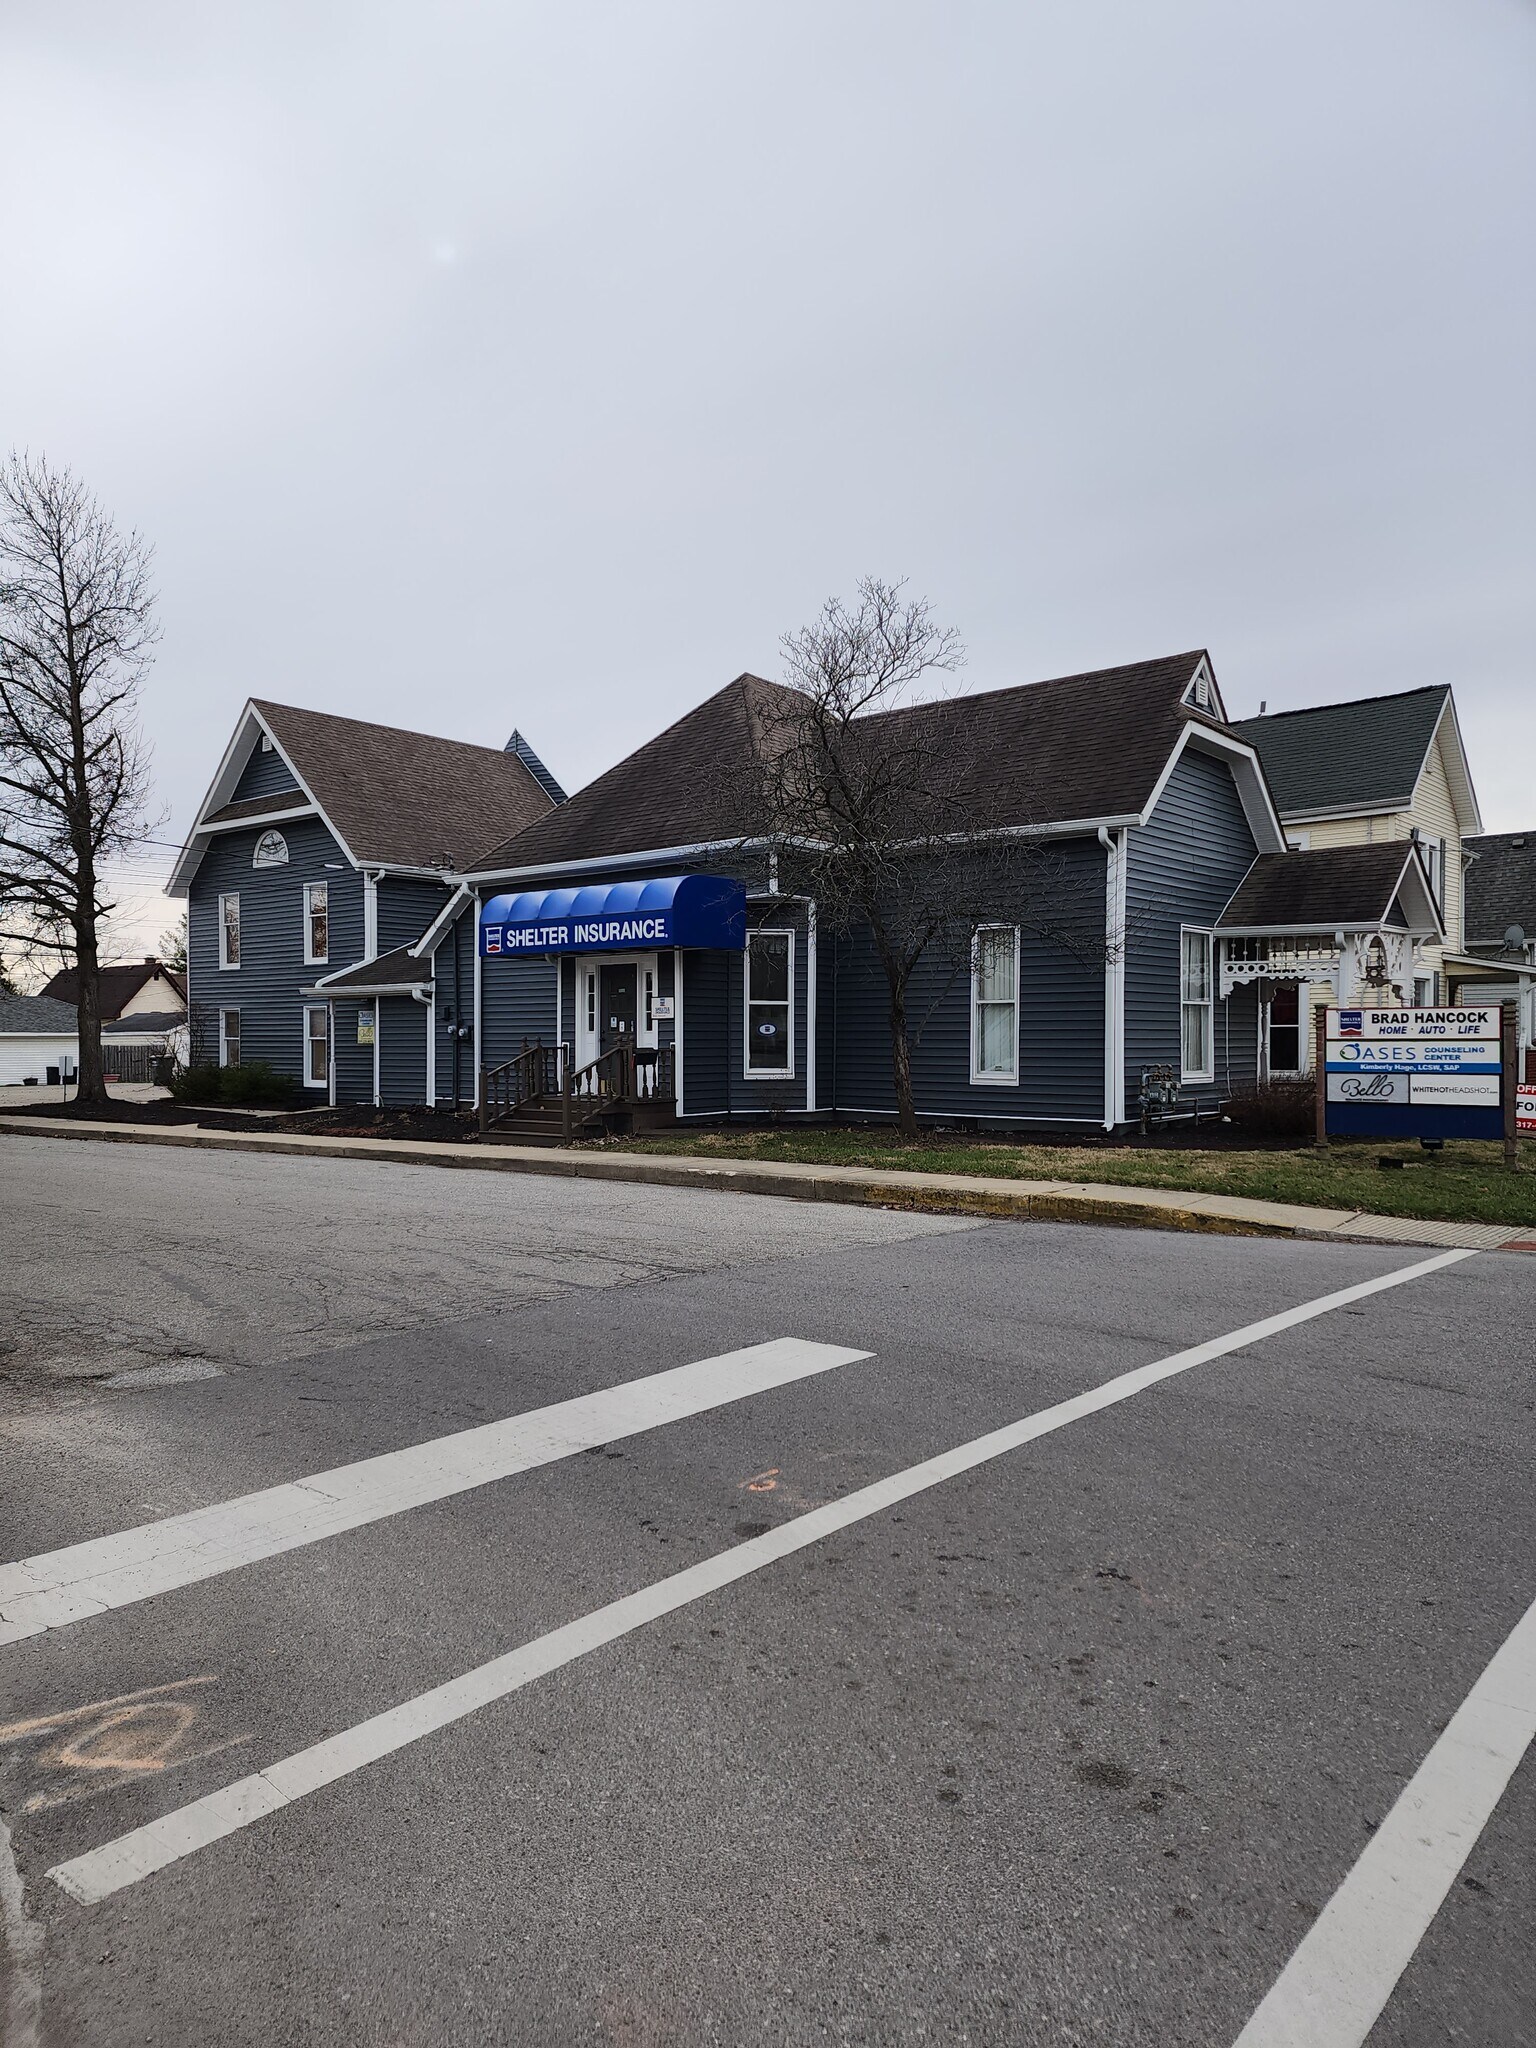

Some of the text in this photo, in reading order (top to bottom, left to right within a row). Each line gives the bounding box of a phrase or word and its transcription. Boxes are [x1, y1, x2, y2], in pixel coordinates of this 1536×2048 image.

[507, 918, 665, 948] SHELTER INSURANCE
[1371, 1012, 1488, 1024] BRAD HANCOCK
[1379, 1025, 1480, 1034] HOME AUTO LIFE
[1516, 1102, 1536, 1111] FO
